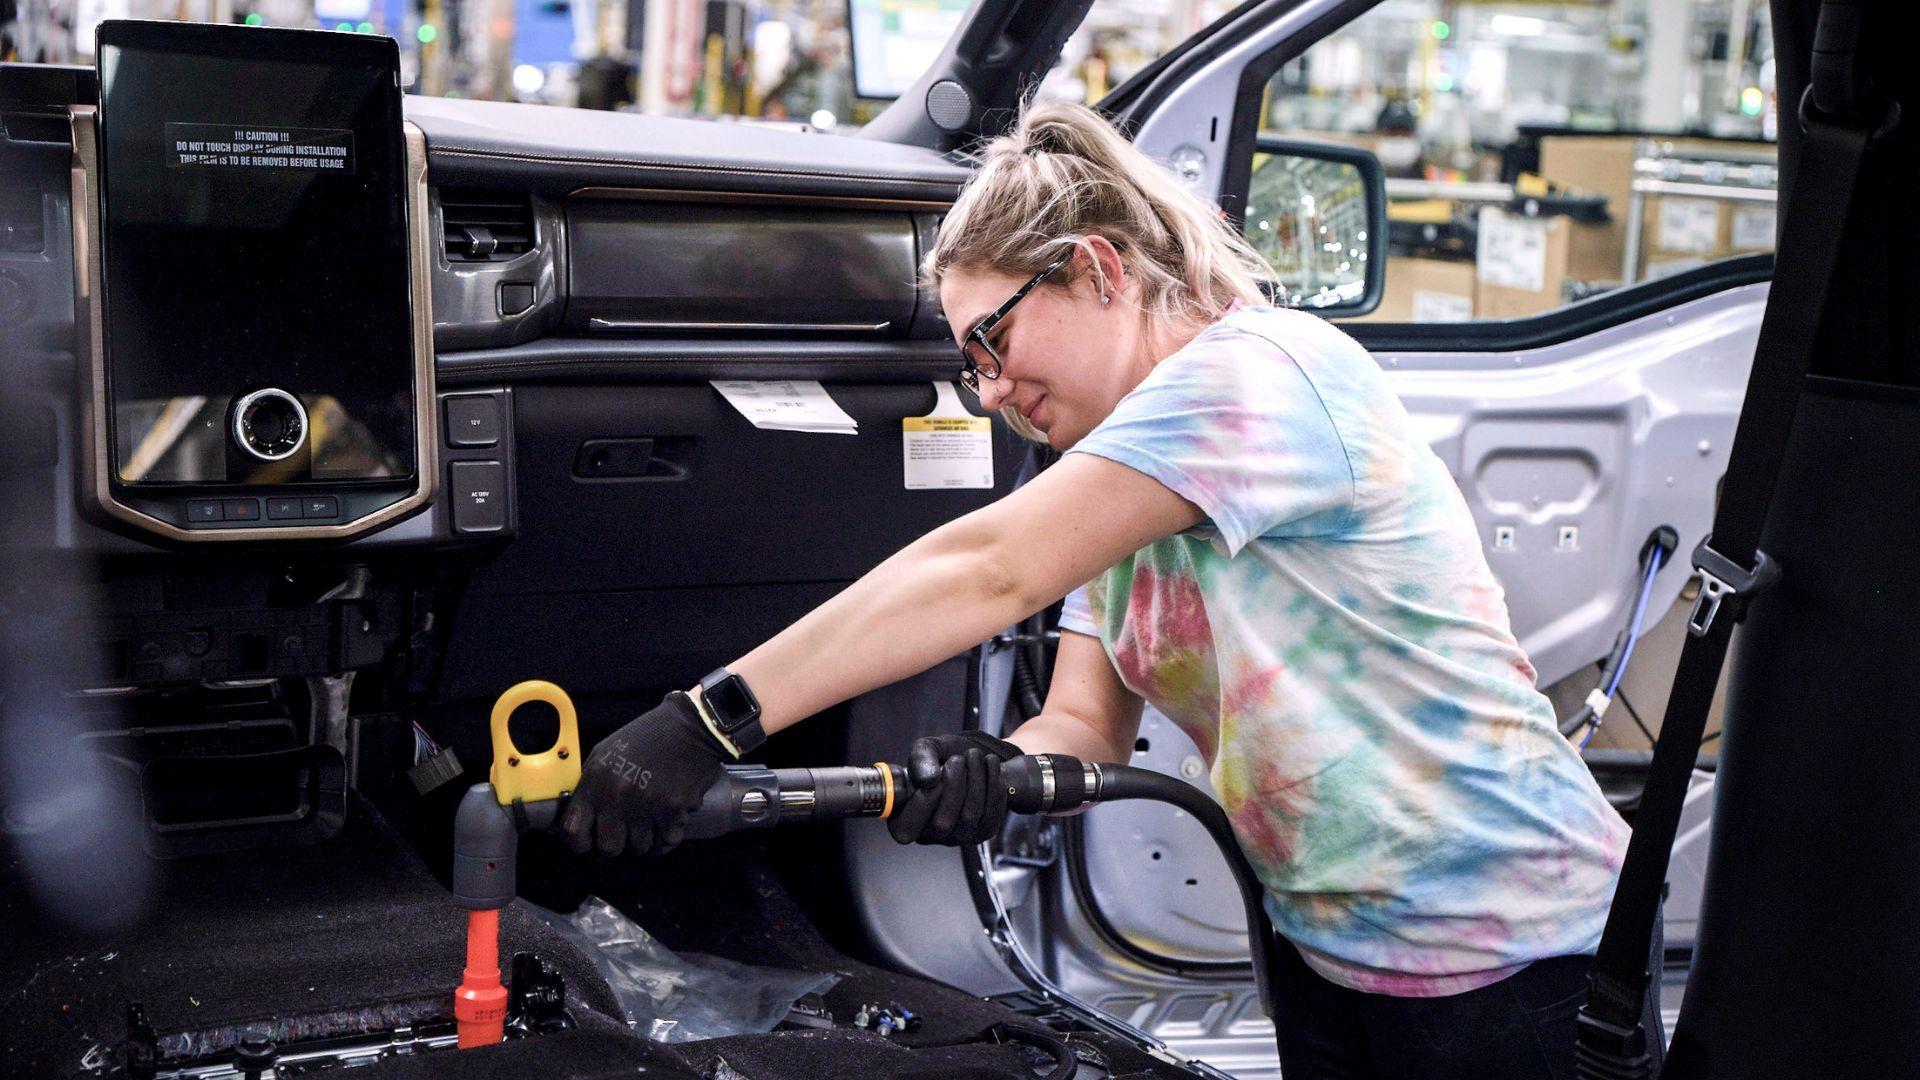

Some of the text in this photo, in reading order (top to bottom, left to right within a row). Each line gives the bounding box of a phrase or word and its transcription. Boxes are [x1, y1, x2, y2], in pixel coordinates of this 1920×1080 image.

[234, 130, 289, 142] !!! CAUTION !!!
[176, 141, 347, 156] DO NOT TOUCH DISPLAY DURING INSTALLATION
[179, 154, 344, 168] THIS FILM IS TO BE REMOVED BEFORE USAGE
